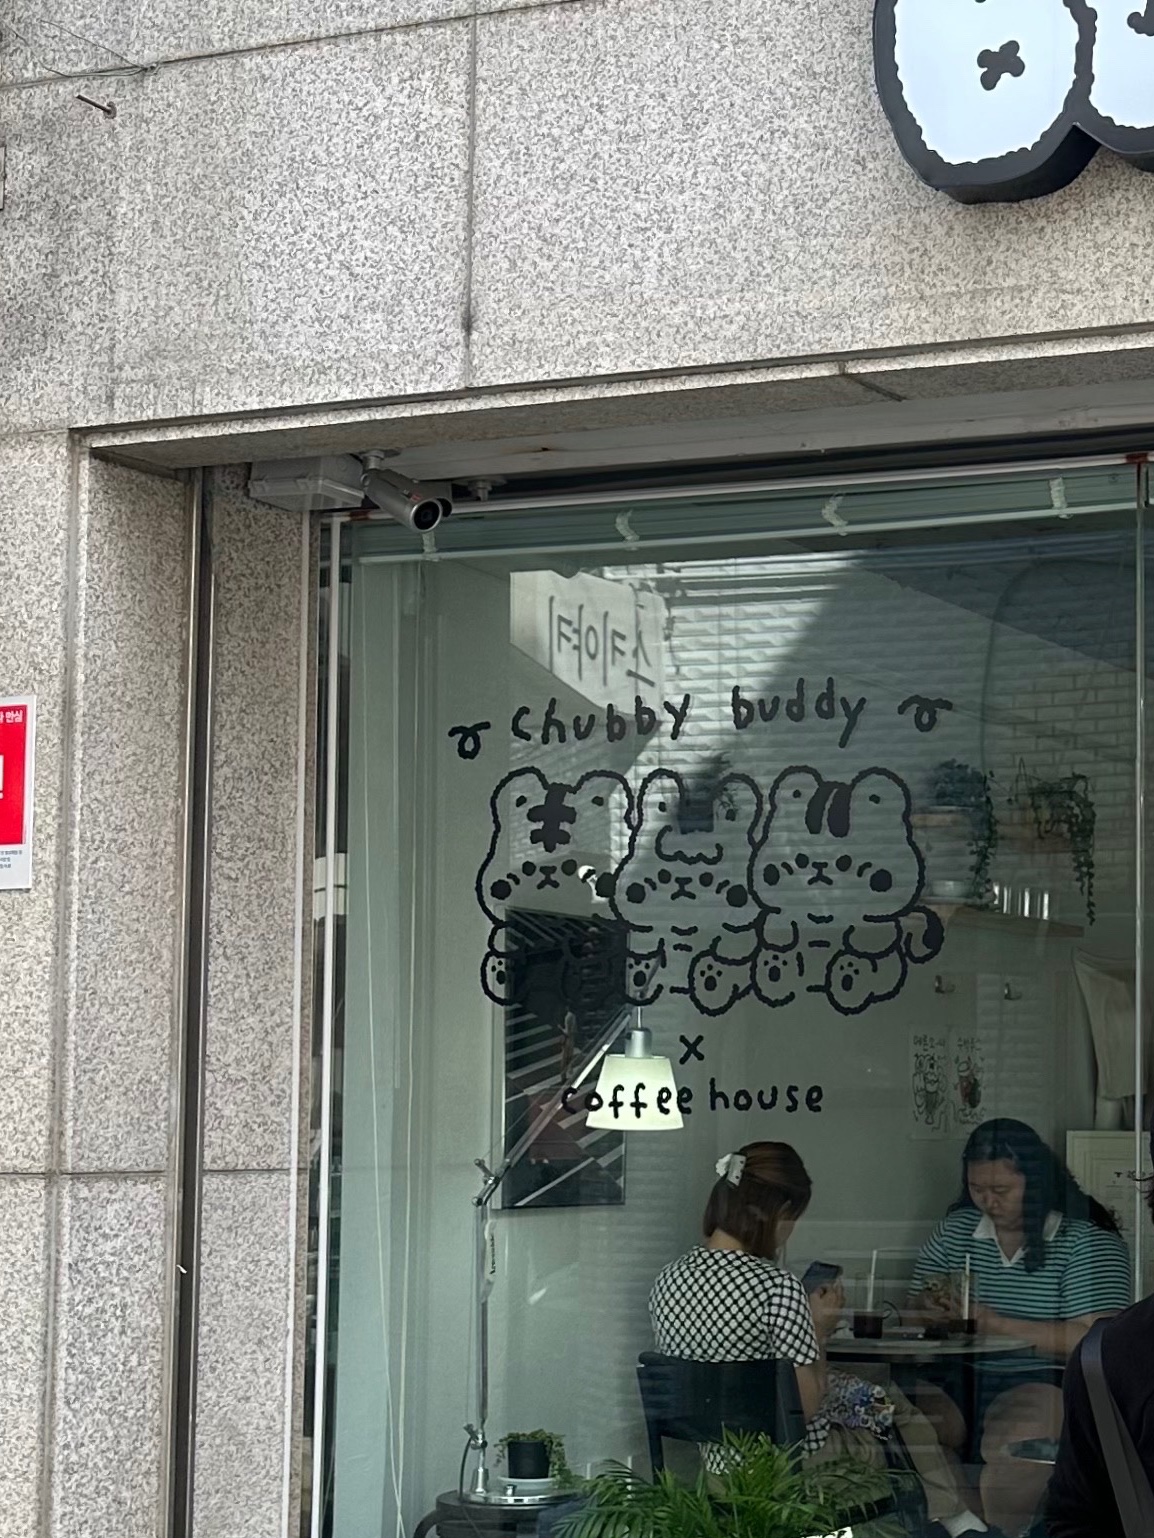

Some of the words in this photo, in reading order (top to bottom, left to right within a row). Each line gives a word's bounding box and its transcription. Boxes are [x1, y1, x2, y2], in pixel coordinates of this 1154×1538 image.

[511, 694, 690, 745] chubby
[732, 677, 867, 748] buddy
[562, 1082, 693, 1118] coffee
[709, 1077, 824, 1113] house
